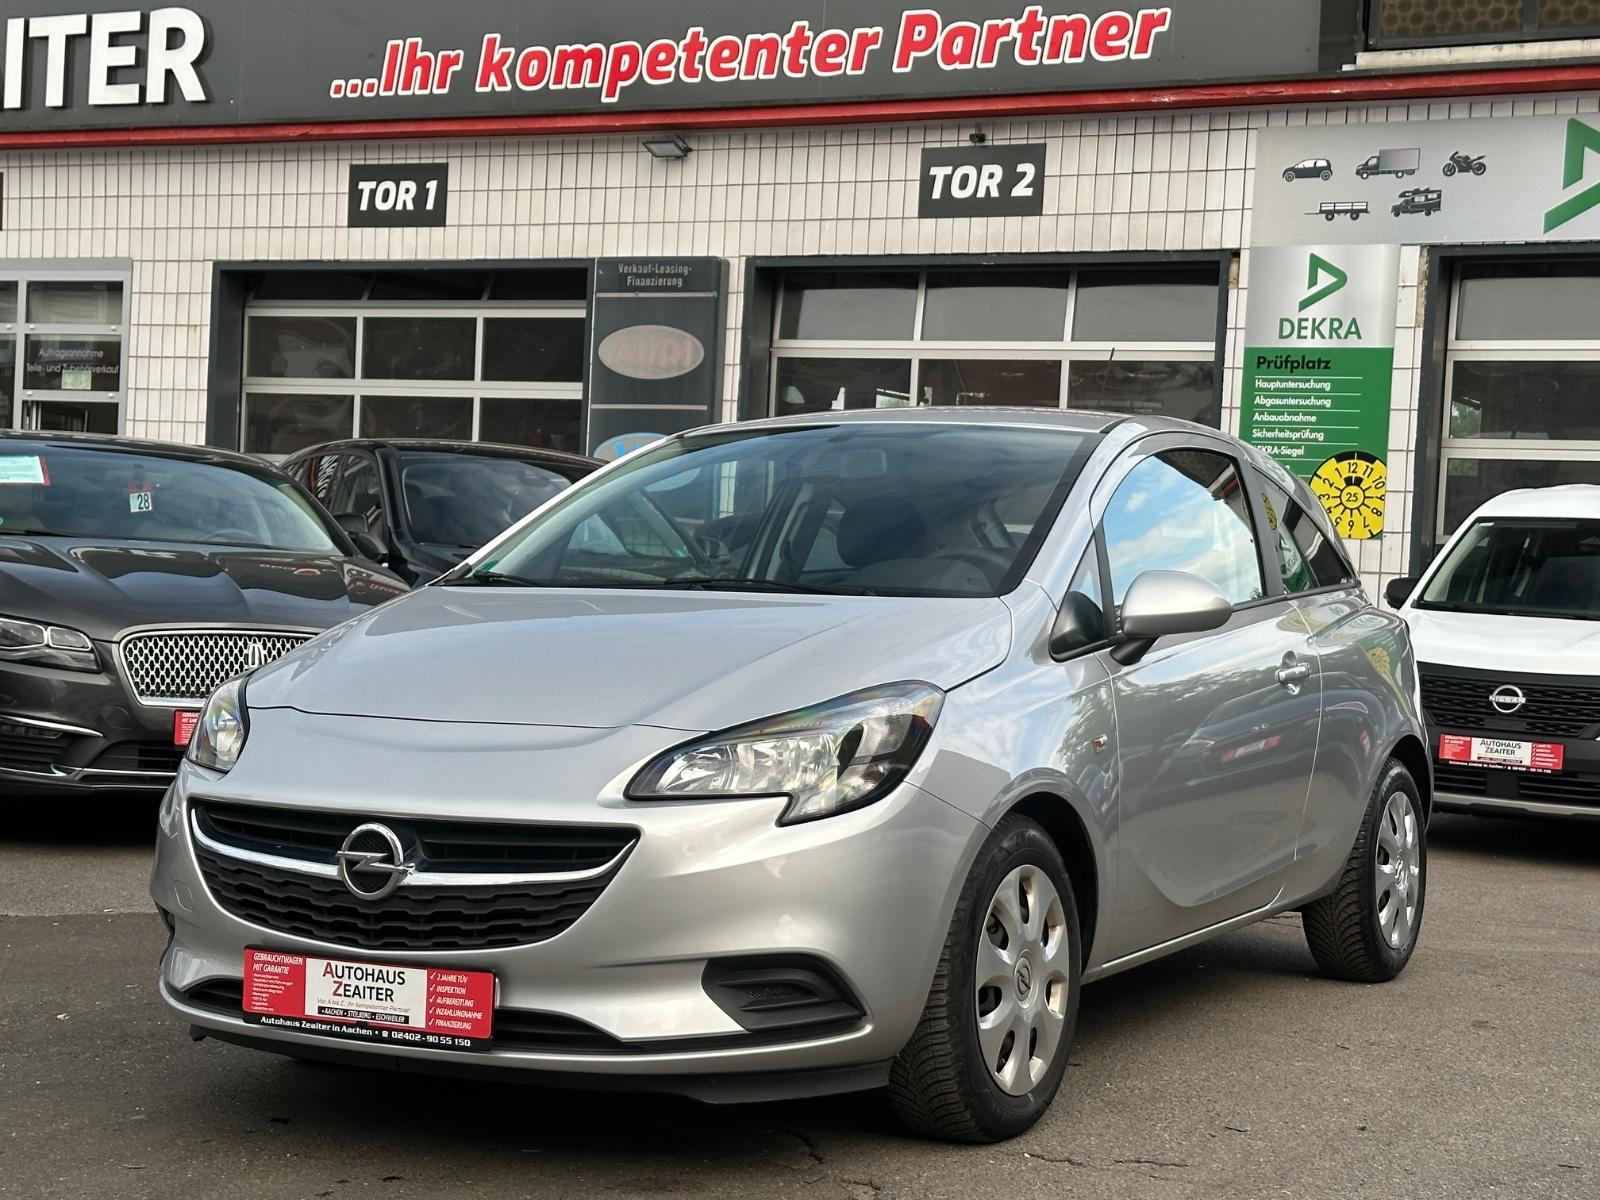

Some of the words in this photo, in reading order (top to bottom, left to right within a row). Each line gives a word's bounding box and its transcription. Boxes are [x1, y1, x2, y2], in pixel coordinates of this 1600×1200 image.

[3, 7, 207, 109] ITER
[475, 20, 884, 103] kompetenter
[892, 5, 1172, 73] Partner
[929, 164, 1003, 199] TOR
[1010, 162, 1036, 197] 2
[357, 180, 417, 211] TOR
[425, 180, 438, 211] 1
[627, 275, 683, 288] Finanzierung
[1278, 317, 1362, 340] DEKRA
[1256, 355, 1331, 373] Prüfplatz
[1255, 379, 1331, 391] Hauptuntersuchung
[1253, 395, 1331, 408] Abgasuntersuchung
[1252, 412, 1317, 422] Anbauabnahme
[1252, 428, 1324, 441] Sicherheitsprüfung
[1335, 467, 1342, 478] 1
[1347, 462, 1358, 473] 12
[1363, 464, 1374, 478] 11
[1322, 477, 1334, 488] 2
[1372, 476, 1385, 490] 10
[137, 493, 150, 510] 28
[1346, 493, 1358, 502] 25
[1371, 507, 1382, 517] 8
[1348, 520, 1354, 532] 6
[1363, 516, 1370, 528] 7
[1480, 739, 1521, 749] AUTOHAUS
[1485, 746, 1516, 756] ZEAITER
[252, 963, 263, 971] MIT
[263, 964, 290, 974] GARANTIE
[322, 962, 406, 986] AUTOHAUS
[332, 981, 394, 1002] ZEAITER
[261, 1016, 300, 1027] Autohaus
[301, 1021, 331, 1031] Zeaiter
[332, 1024, 340, 1032] in
[341, 1025, 373, 1036] Aachen
[440, 1036, 452, 1045] 55
[454, 1038, 470, 1047] 150
